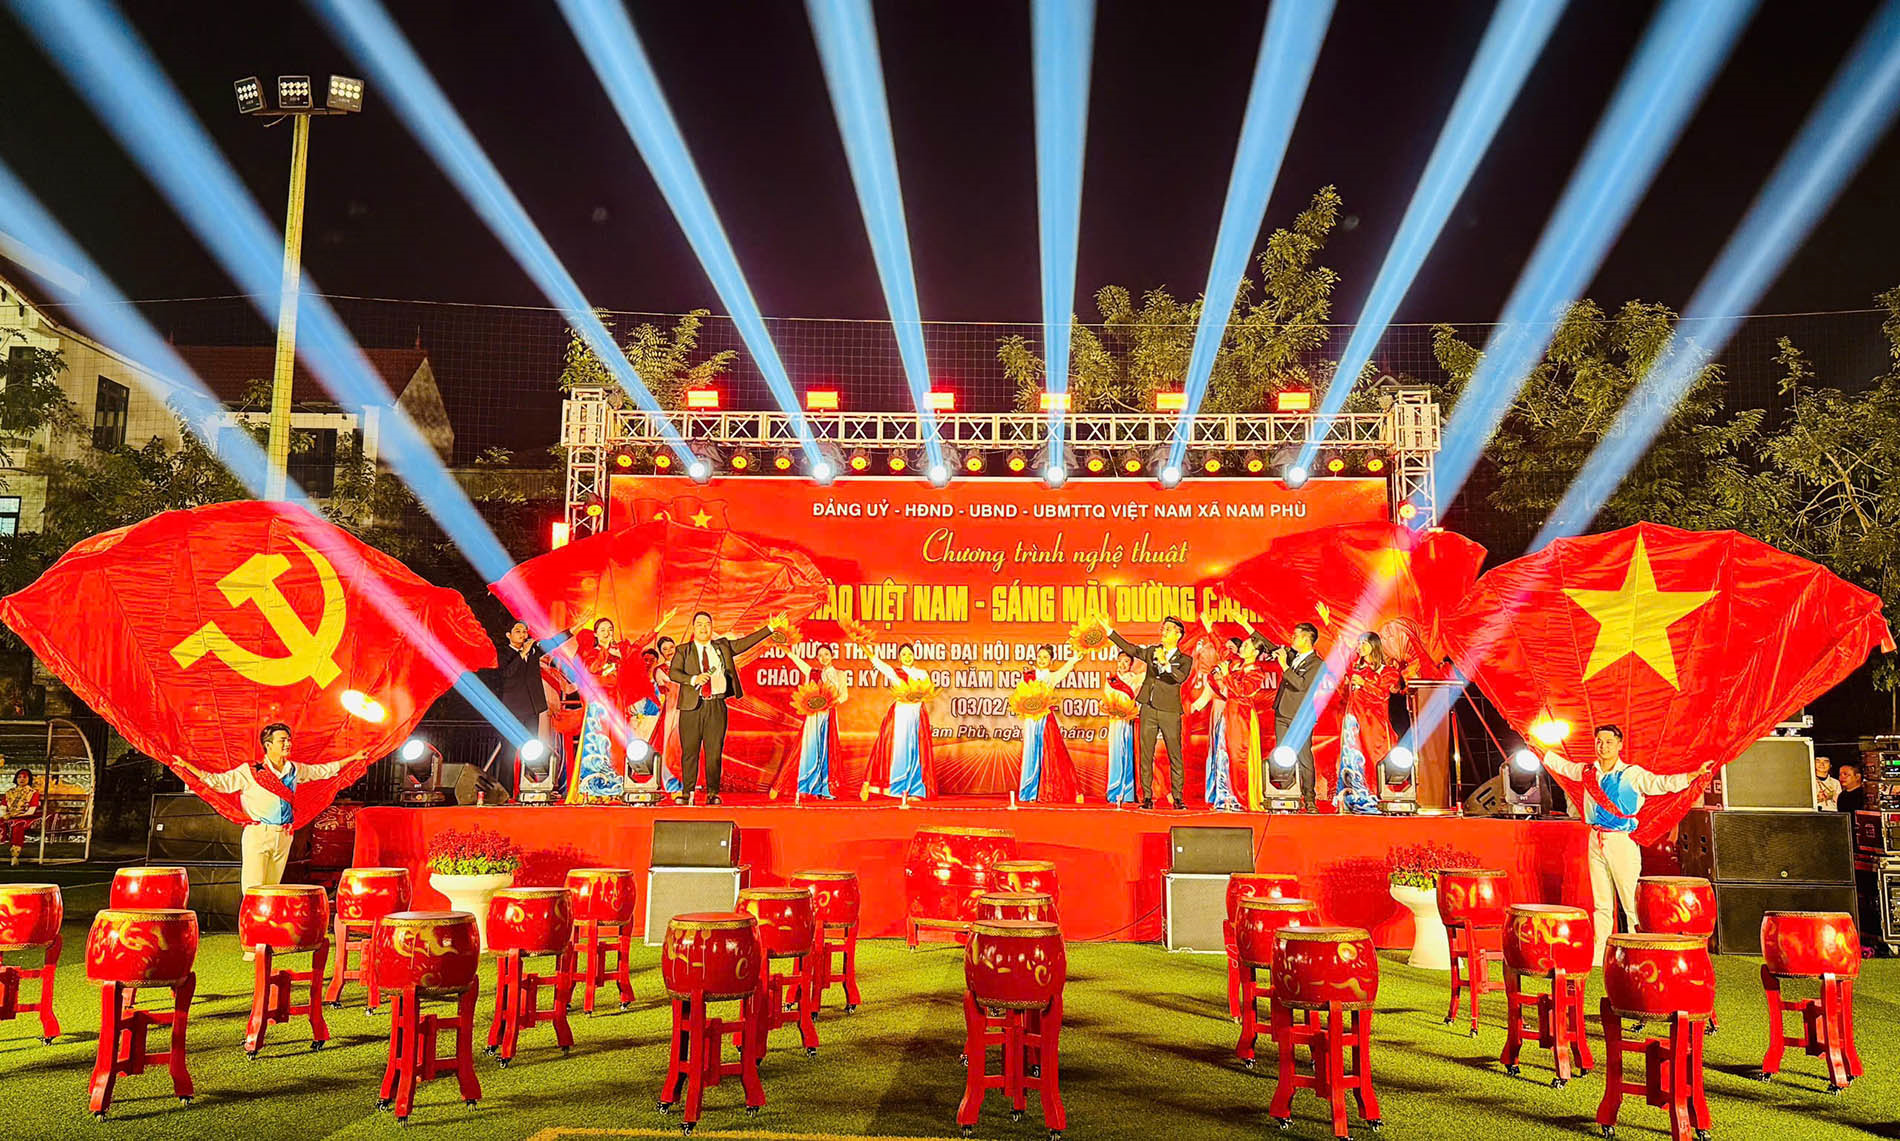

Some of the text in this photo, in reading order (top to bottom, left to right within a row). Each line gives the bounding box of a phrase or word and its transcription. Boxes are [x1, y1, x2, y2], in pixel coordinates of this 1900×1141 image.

[813, 499, 861, 516] ĐẢNG
[867, 499, 889, 517] UỶ
[905, 504, 953, 517] HĐND
[970, 504, 1017, 518] UBND
[1033, 504, 1105, 518] UBMTTQ
[1111, 501, 1149, 520] VIỆT
[1154, 504, 1192, 518] NAM
[1198, 501, 1221, 518] XÃ
[1226, 504, 1264, 518] NAM
[1270, 501, 1306, 518] PHÙ
[922, 527, 1187, 573] Chương trình nghệ thuật
[859, 577, 908, 630] VIỆT
[913, 585, 969, 622] NAM
[992, 579, 1055, 622] SÁNG
[1115, 580, 1196, 623] ĐƯỜNG
[792, 639, 839, 660] MỪG
[913, 640, 946, 660] ÔNG
[951, 643, 977, 664] ĐẠI
[983, 640, 1010, 664] HỘI
[756, 665, 800, 686] CHÀO
[931, 671, 951, 688] 96
[956, 668, 993, 688] NĂM
[930, 727, 953, 738] am
[1059, 726, 1096, 742] háng
